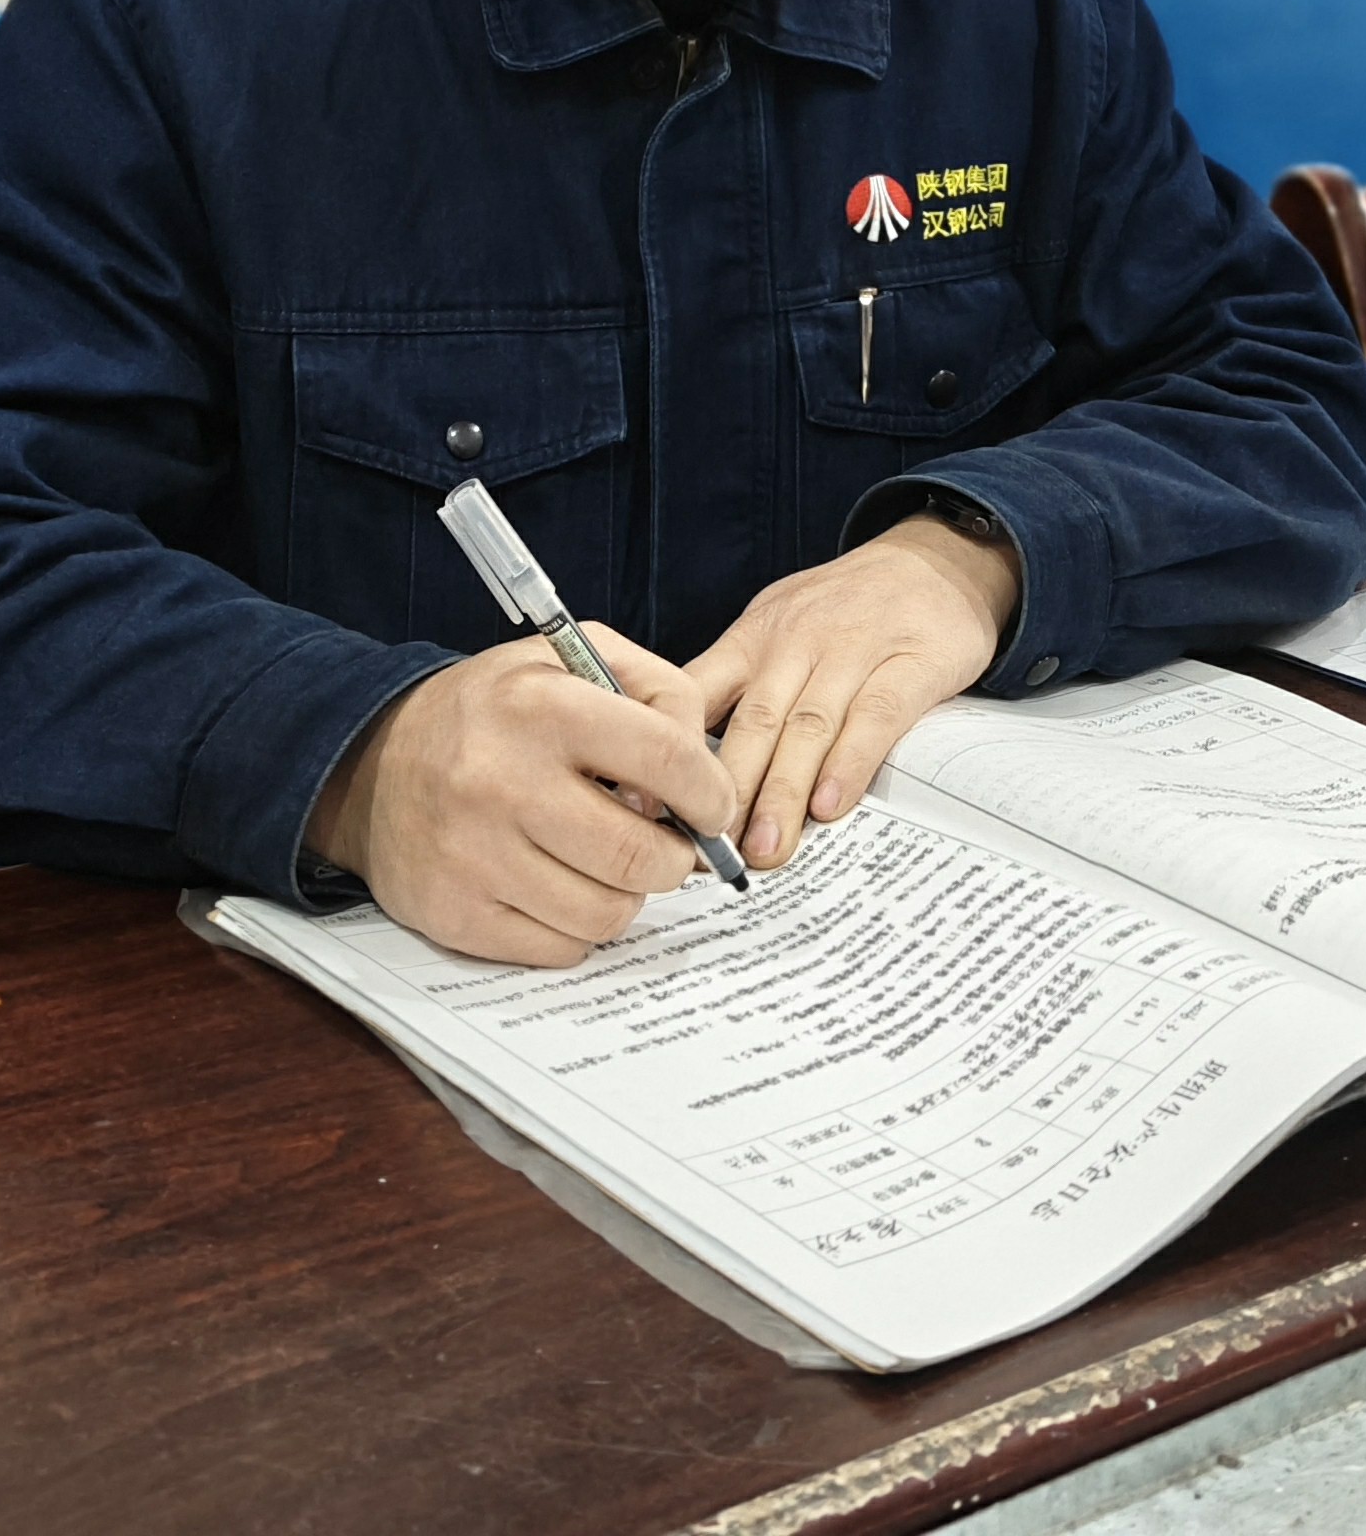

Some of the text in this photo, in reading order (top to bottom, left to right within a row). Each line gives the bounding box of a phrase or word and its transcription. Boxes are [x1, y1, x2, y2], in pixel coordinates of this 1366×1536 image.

[916, 163, 1008, 202] 陕钢集团
[922, 202, 1006, 240] 汉钢公司
[1026, 1060, 1228, 1223] 班组生产安全日志
